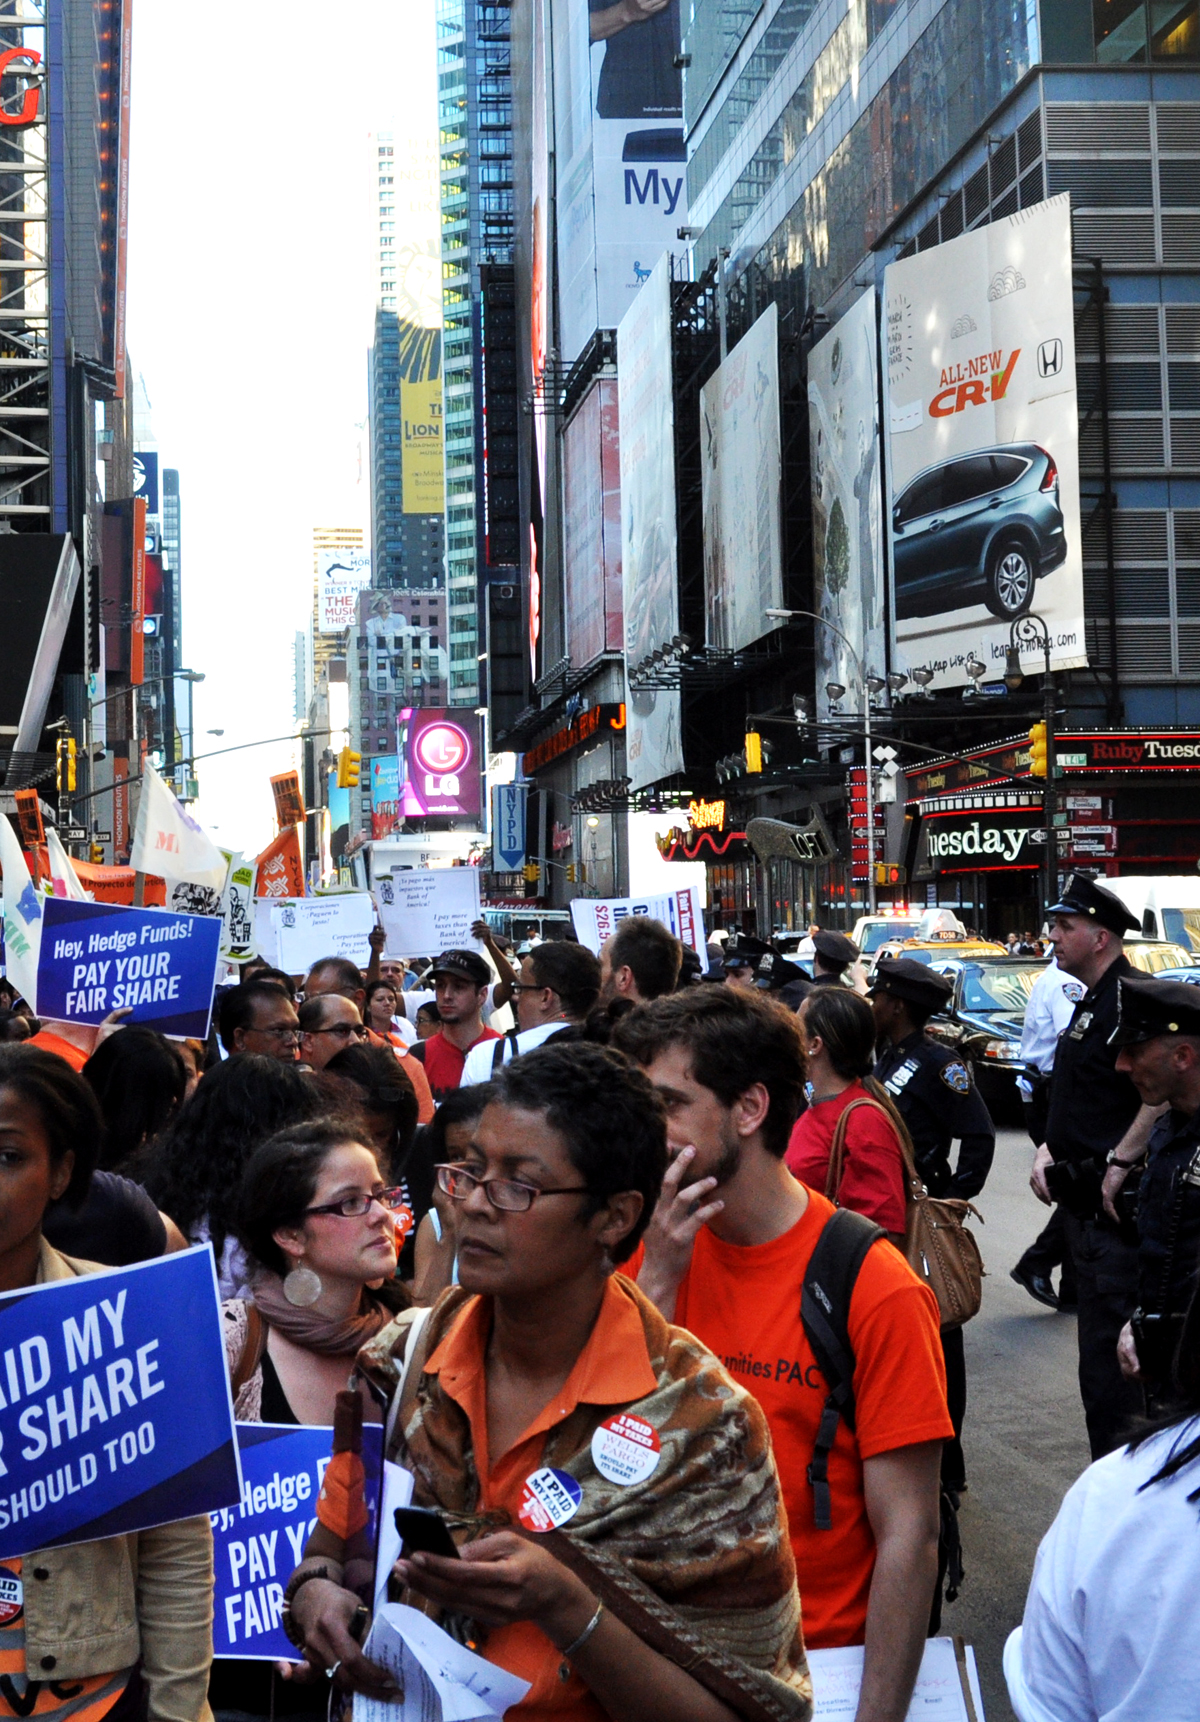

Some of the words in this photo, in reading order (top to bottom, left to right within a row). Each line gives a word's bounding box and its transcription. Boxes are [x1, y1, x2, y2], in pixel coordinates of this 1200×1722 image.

[624, 168, 684, 215] My
[928, 348, 1022, 418] CR-V
[939, 350, 1002, 388] ALL-NEW
[325, 587, 347, 595] BEST
[327, 596, 353, 606] THE
[115, 774, 123, 808] REUTRS
[424, 774, 460, 796] LG
[505, 788, 517, 850] NYPD
[790, 832, 826, 859] LOFT
[88, 877, 125, 889] Proyecto
[54, 939, 84, 960] Hey,
[88, 930, 137, 953] Hedge
[140, 918, 194, 945] Funds!
[73, 960, 111, 989] PAY
[115, 951, 171, 982] YOUR
[66, 986, 107, 1015] FAIR
[111, 975, 182, 1008] SHARE
[62, 1288, 128, 1374] MY
[775, 1358, 820, 1389] PAC
[18, 1338, 165, 1461] SHARE
[610, 1422, 625, 1434] MY
[619, 1415, 627, 1425] I
[626, 1418, 652, 1437] PAID
[102, 1420, 156, 1473] TOO
[600, 1454, 624, 1469] SHOULD
[625, 1465, 638, 1474] PAY
[601, 1443, 646, 1468] FARGO
[606, 1434, 649, 1459] WELLS
[531, 1478, 545, 1495] MY
[600, 1461, 610, 1470] ITS
[611, 1467, 632, 1479] SHARE
[239, 1471, 311, 1518] Hedge
[541, 1472, 551, 1483] I
[547, 1480, 572, 1512] PAID
[228, 1529, 278, 1588] PAY
[225, 1582, 285, 1644] FAIR
